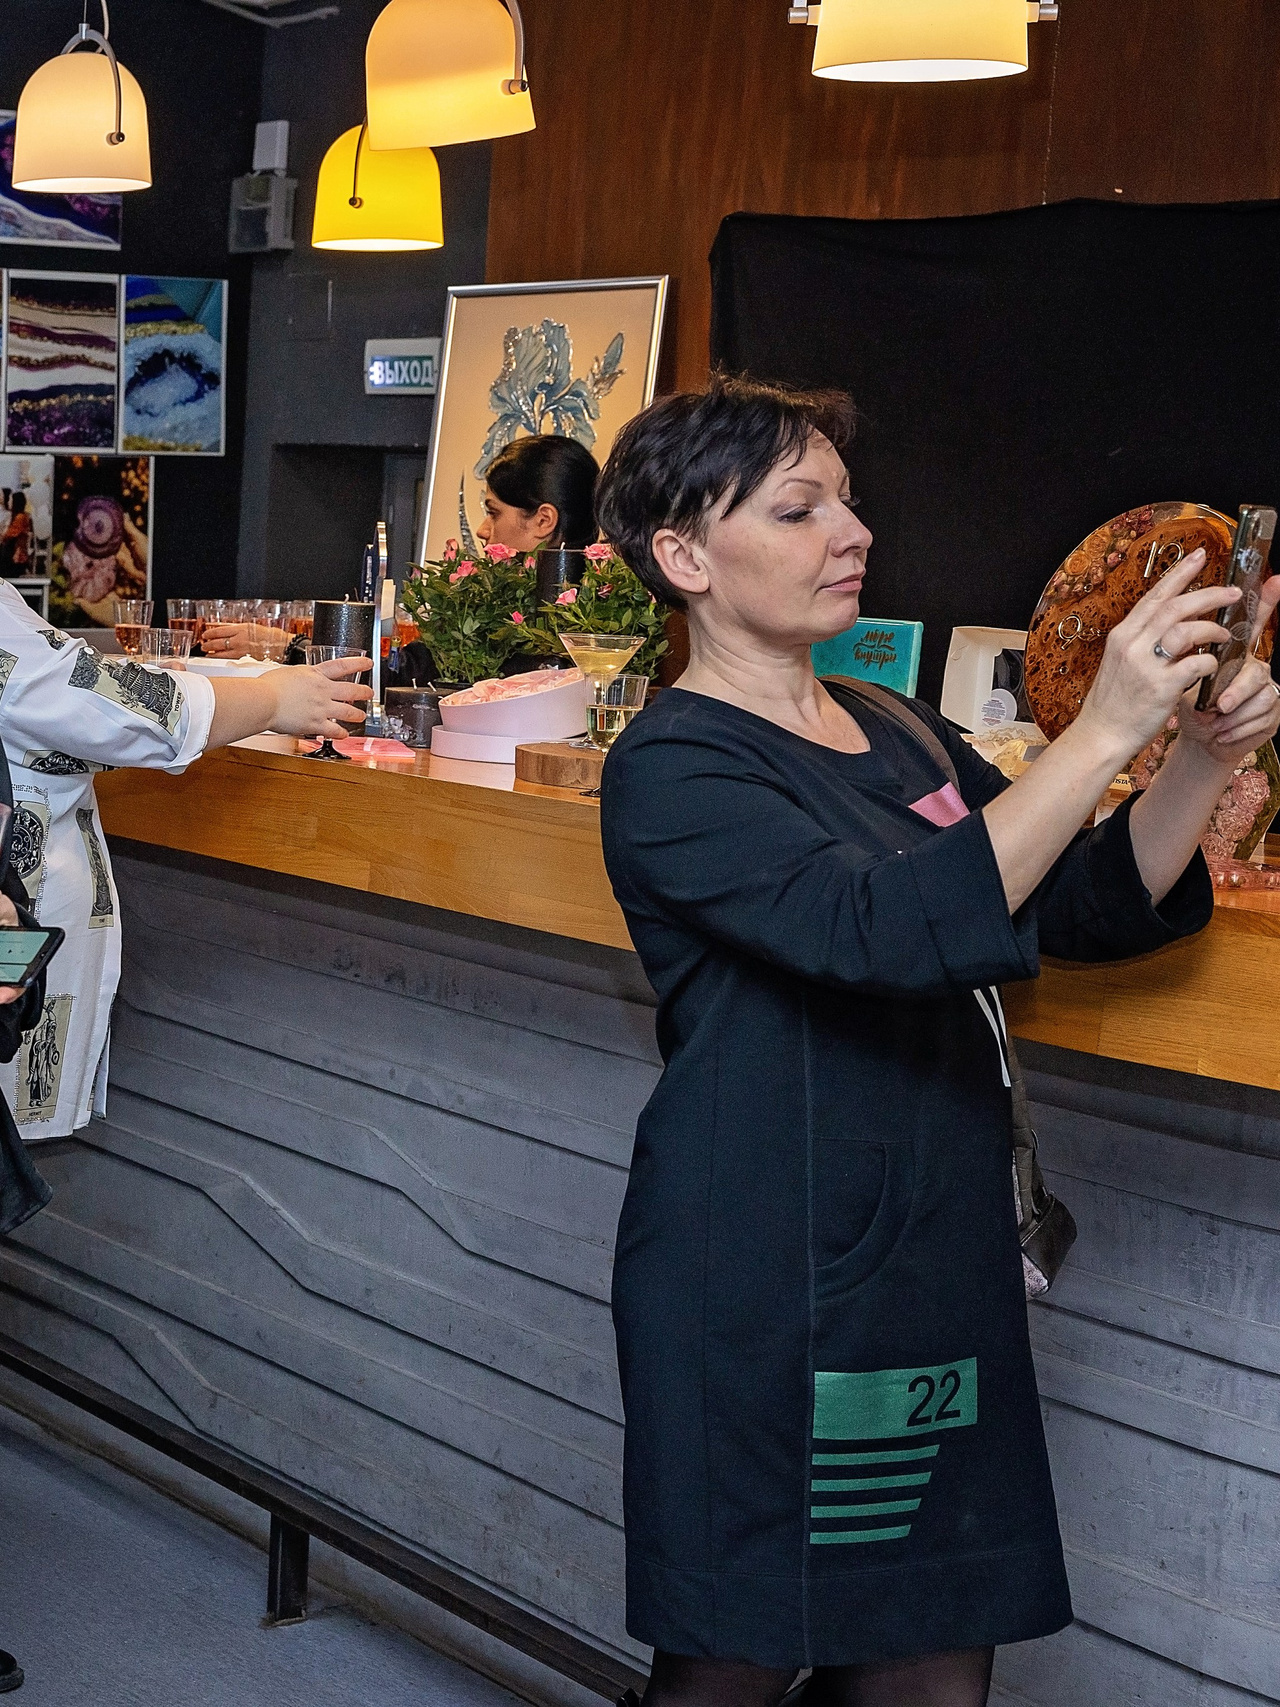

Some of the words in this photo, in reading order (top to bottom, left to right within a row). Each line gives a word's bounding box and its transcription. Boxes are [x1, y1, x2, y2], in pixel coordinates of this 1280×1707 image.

[373, 360, 434, 385] ВЫХОД
[1058, 614, 1082, 650] 9
[906, 1369, 961, 1427] 22
